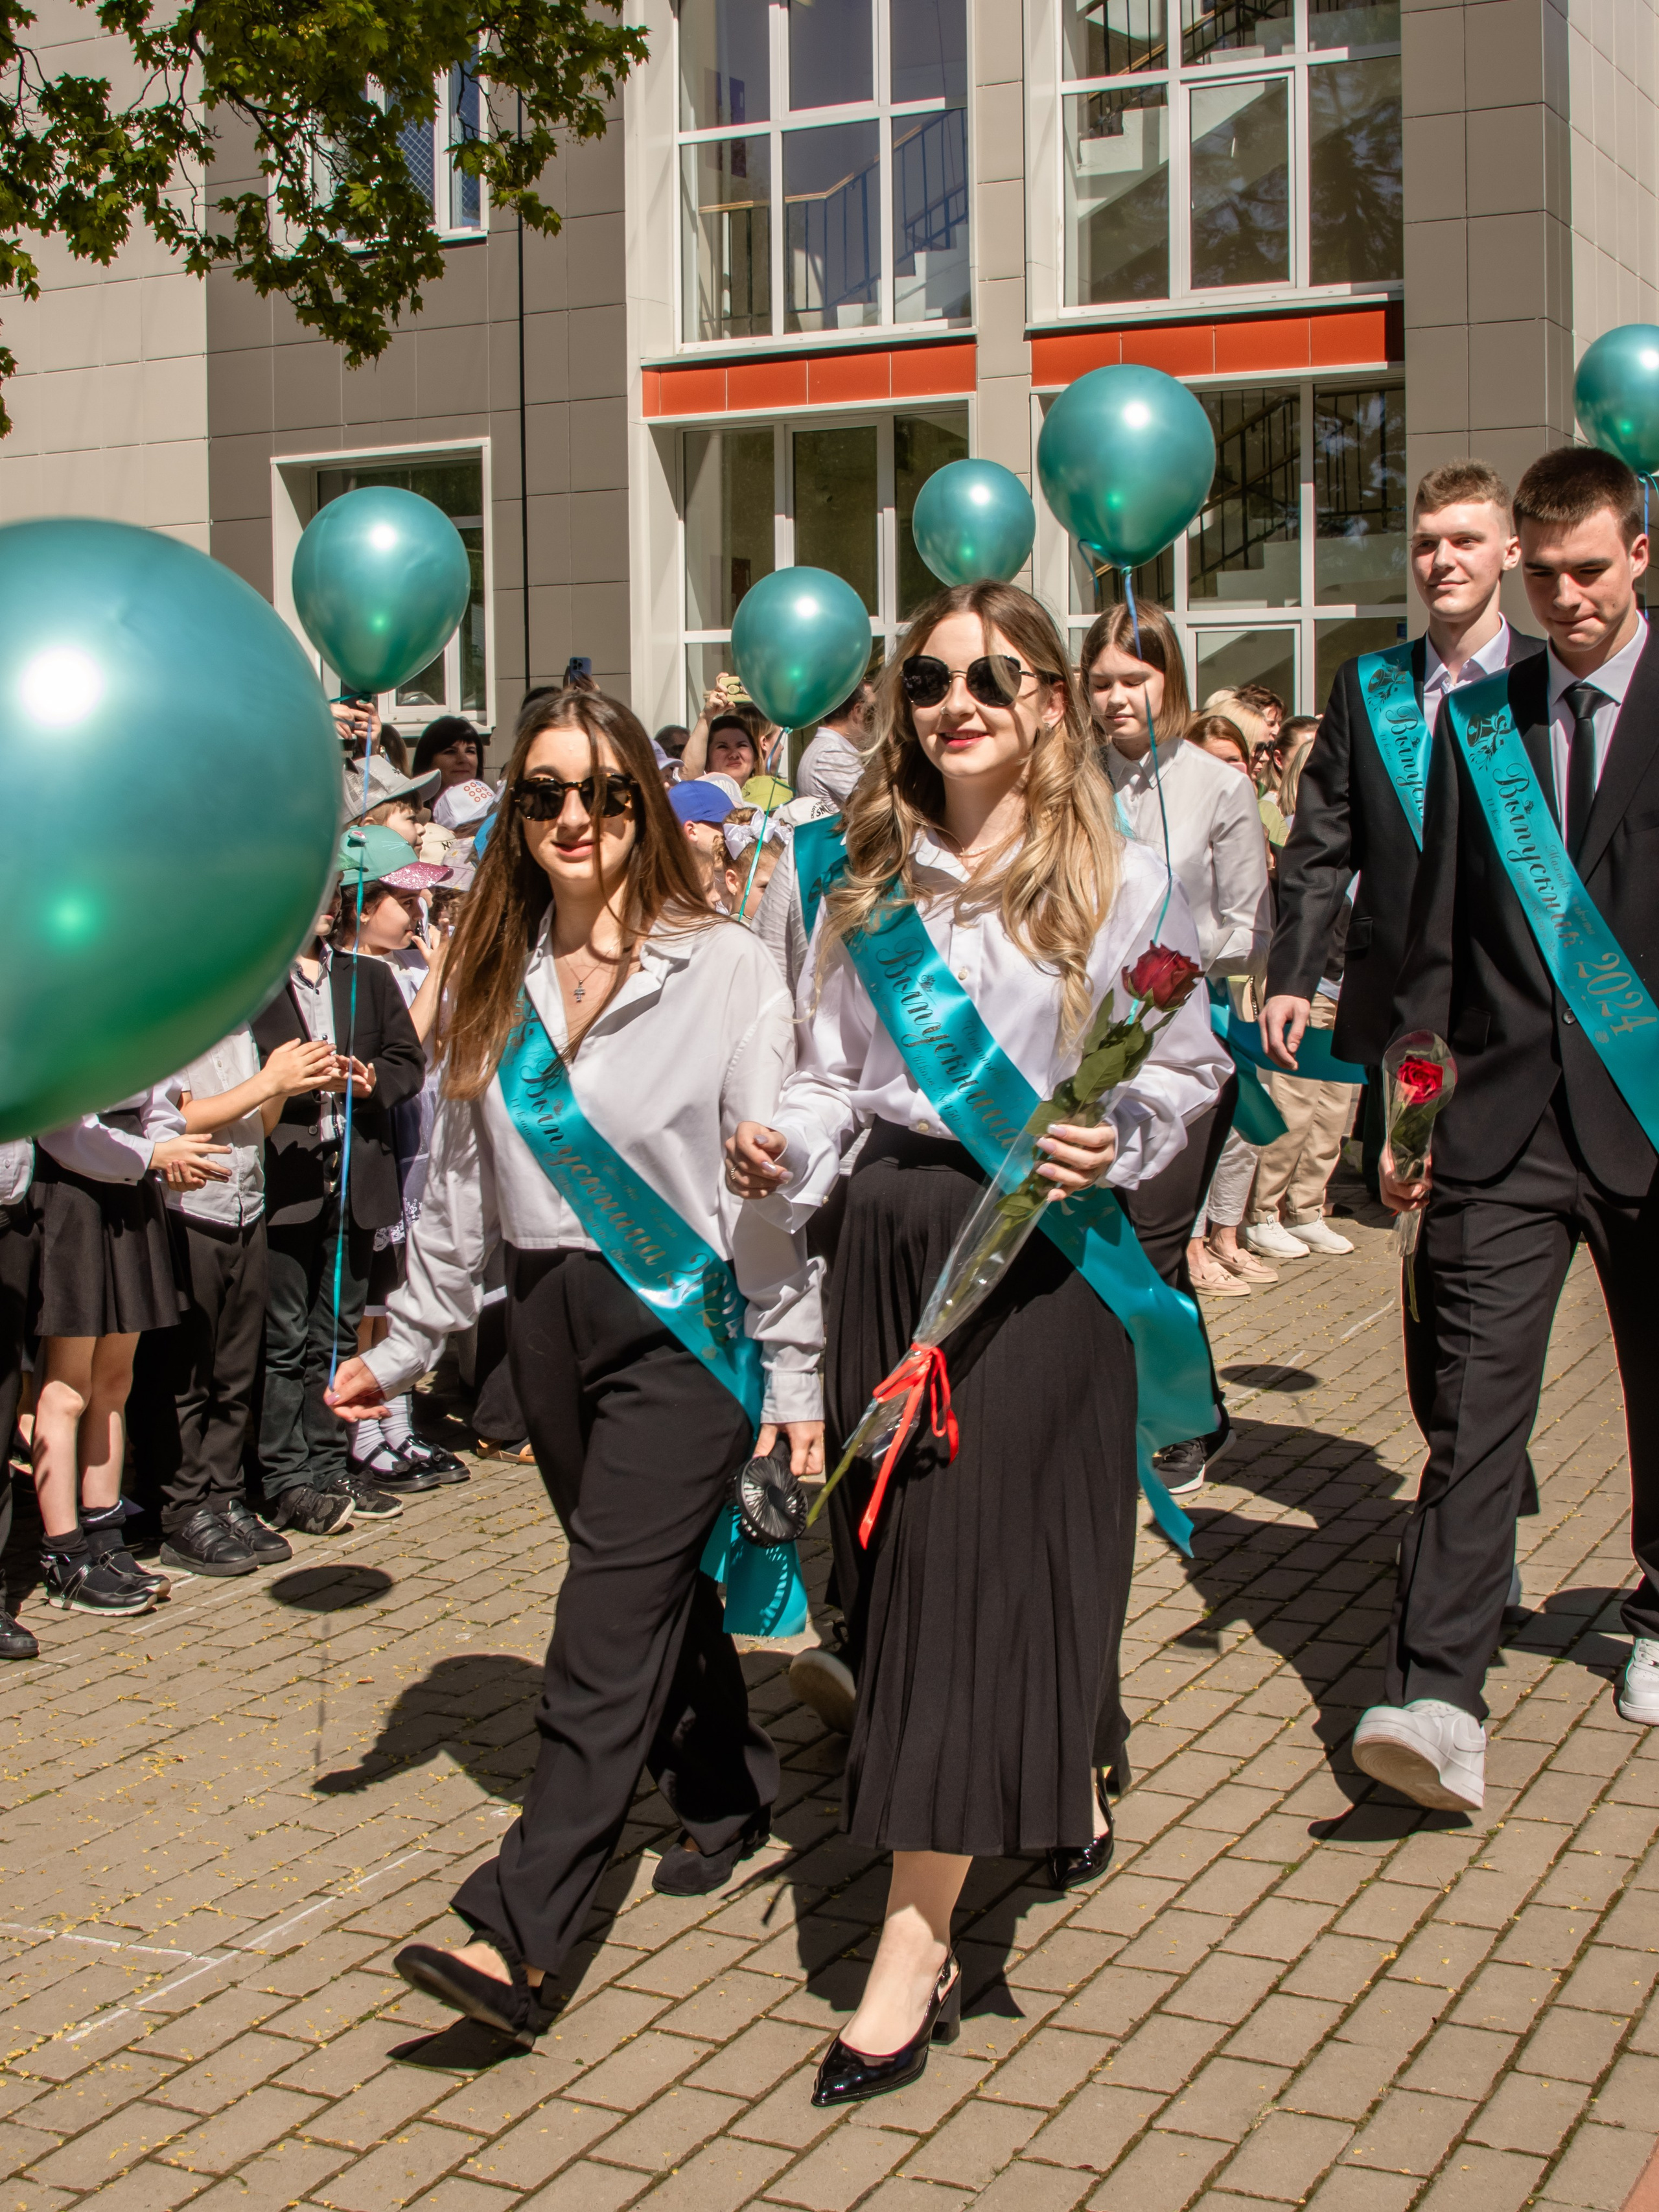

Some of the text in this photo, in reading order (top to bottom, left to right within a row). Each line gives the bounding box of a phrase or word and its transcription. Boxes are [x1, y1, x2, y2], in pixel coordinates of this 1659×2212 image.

[1492, 762, 1658, 1037] Выпускник 2024
[876, 937, 1021, 1149] Выпускница
[519, 1058, 666, 1266] Выпускница
[657, 1252, 743, 1344] 2024
